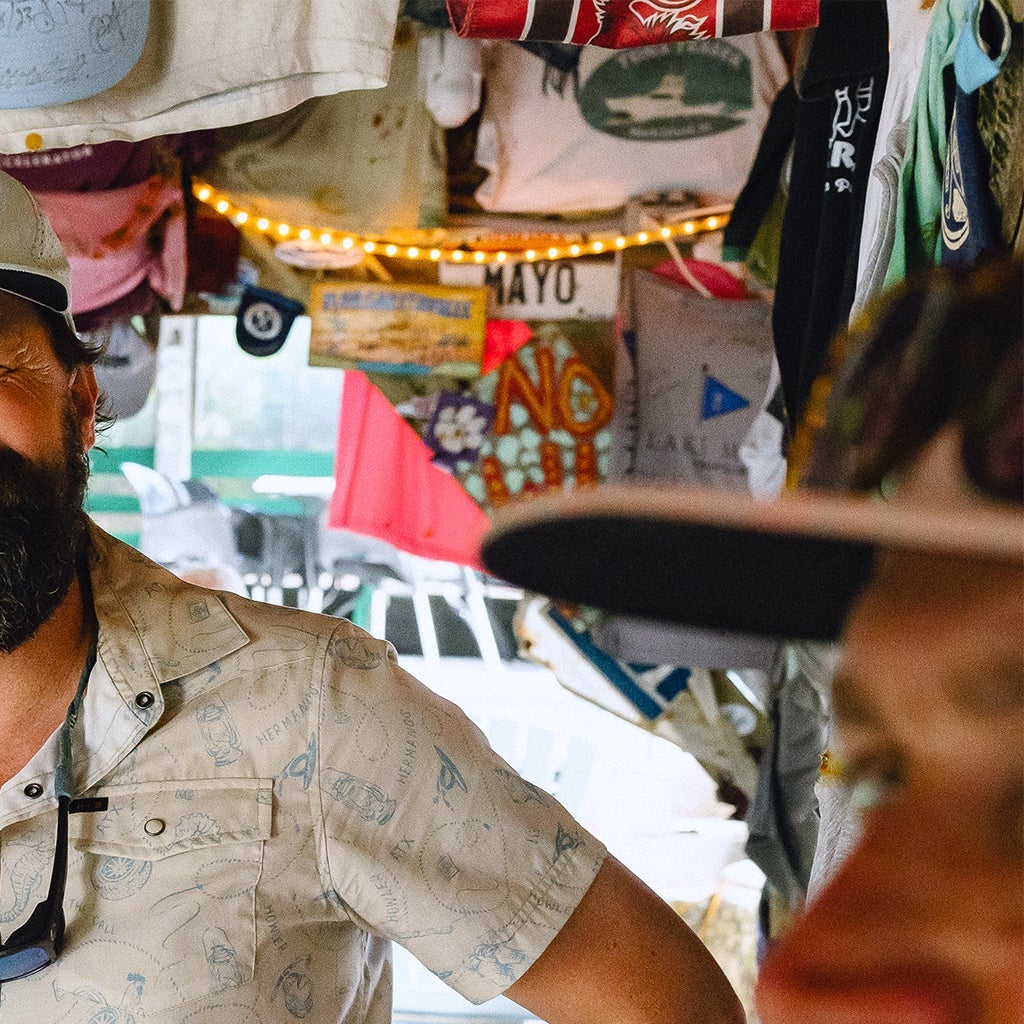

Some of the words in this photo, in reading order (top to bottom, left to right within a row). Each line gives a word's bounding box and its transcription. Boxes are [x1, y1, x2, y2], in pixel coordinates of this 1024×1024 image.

[484, 263, 576, 305] MAYO
[494, 347, 614, 436] NO
[395, 709, 418, 785] HERMANOS
[96, 804, 123, 835] ATX
